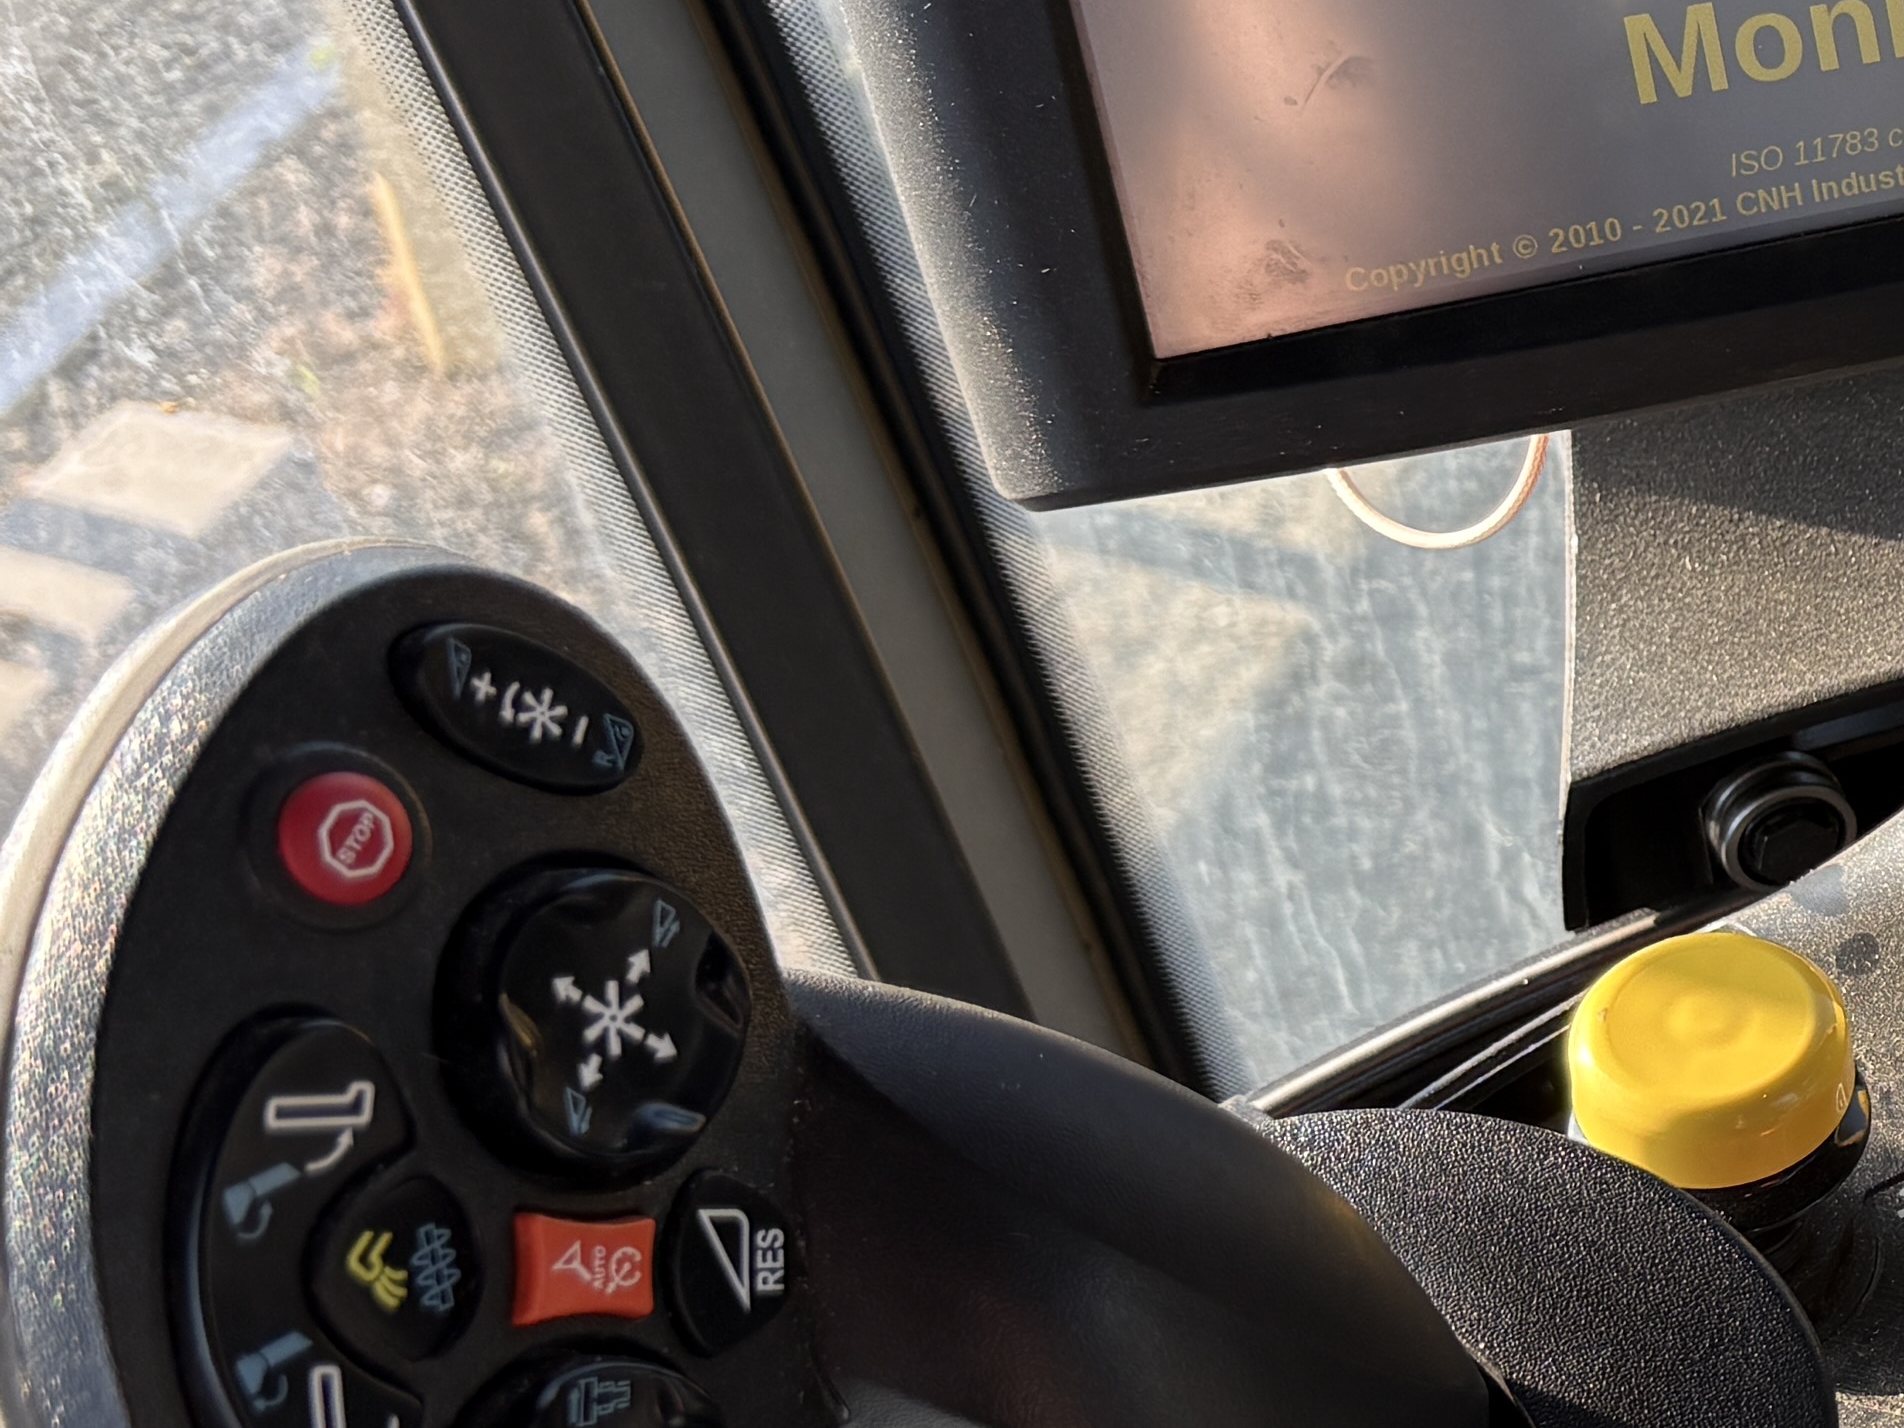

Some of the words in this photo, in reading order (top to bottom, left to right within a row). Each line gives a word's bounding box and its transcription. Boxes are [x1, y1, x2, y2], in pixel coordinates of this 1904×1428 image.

[1731, 145, 1783, 177] ISO
[1794, 127, 1879, 166] 11783
[1345, 241, 1502, 292] Copyright
[1549, 217, 1622, 254] 2010
[1653, 197, 1727, 233] 2021
[1735, 182, 1803, 216] CNH
[336, 811, 374, 864] STOP
[592, 1245, 606, 1289] AUTO
[755, 1228, 785, 1292] RES
